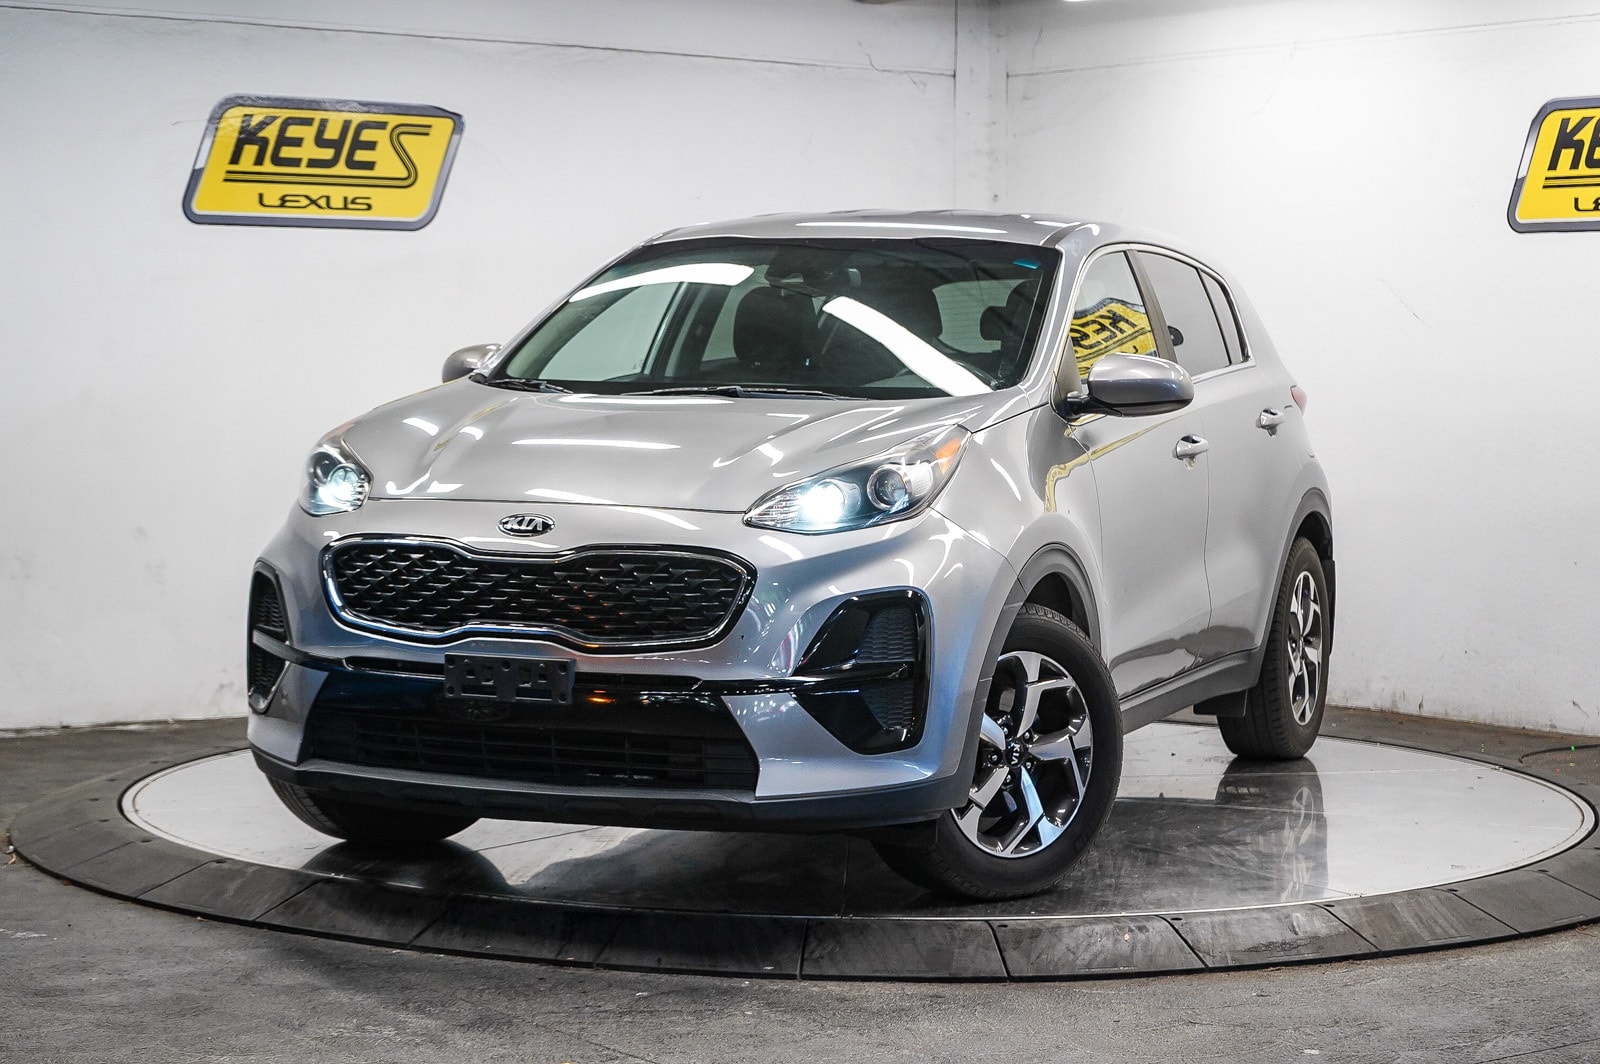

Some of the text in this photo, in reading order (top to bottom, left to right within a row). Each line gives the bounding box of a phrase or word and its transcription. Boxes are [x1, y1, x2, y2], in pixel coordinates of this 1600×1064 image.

[224, 113, 433, 189] KEYES
[258, 193, 373, 212] LEXUS
[504, 516, 543, 531] KIA
[1010, 743, 1021, 765] KIA
